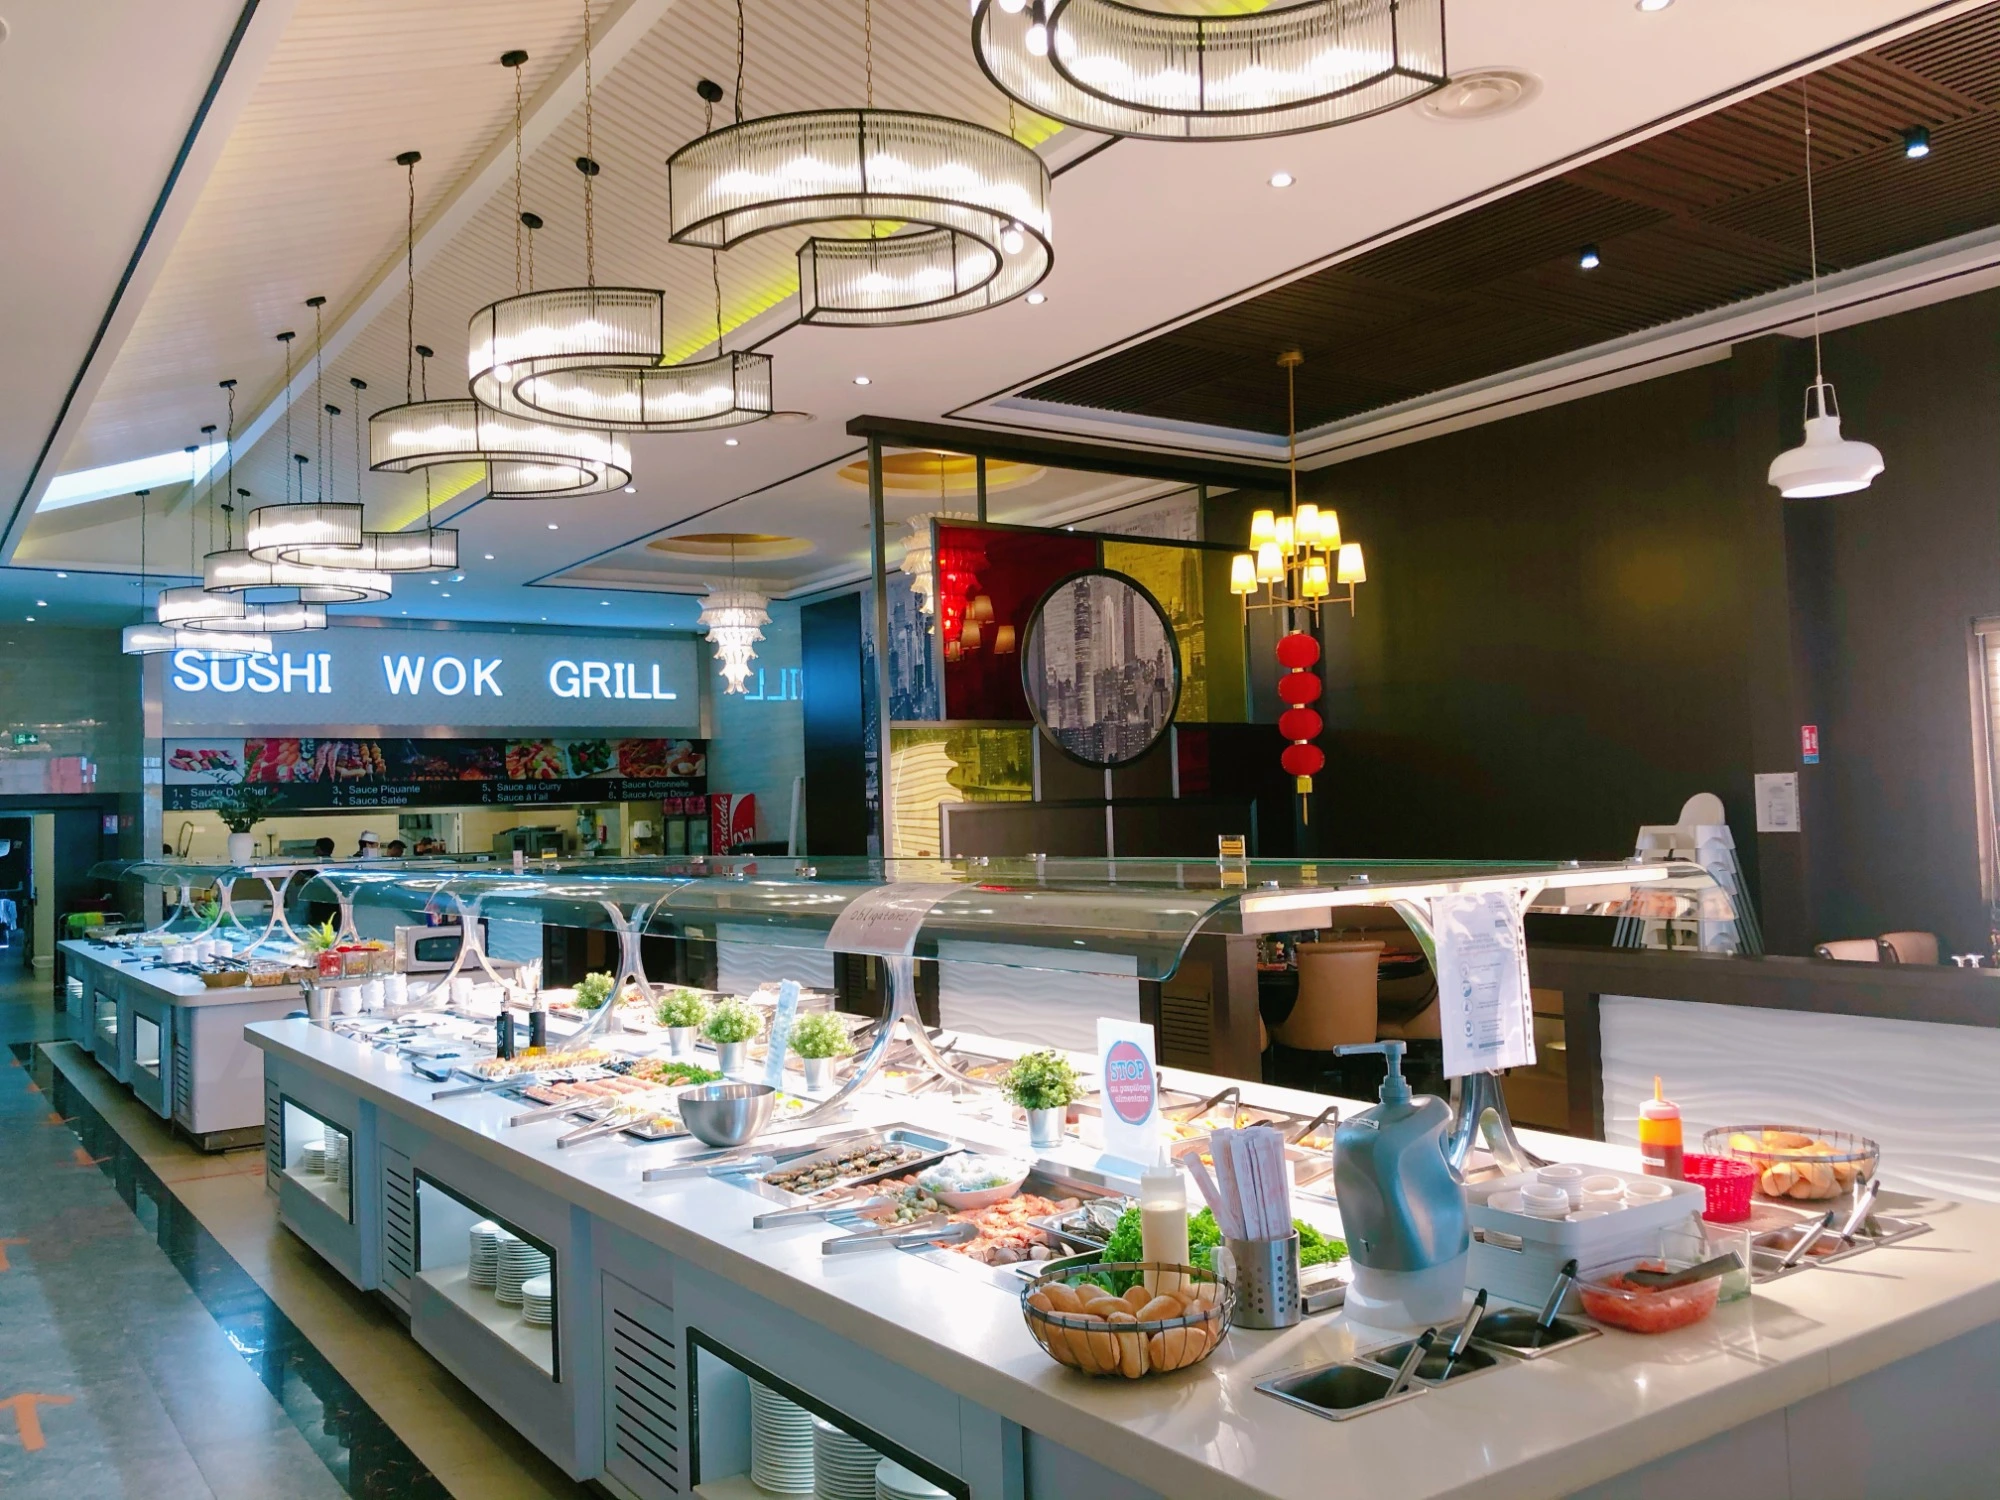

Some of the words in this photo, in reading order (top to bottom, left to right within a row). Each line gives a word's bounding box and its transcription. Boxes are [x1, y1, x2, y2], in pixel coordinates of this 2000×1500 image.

[173, 648, 332, 694] SUSHI
[383, 655, 503, 697] WOK
[549, 660, 677, 700] GRILL
[348, 785, 378, 794] Sauce
[380, 784, 420, 795] Piquante
[496, 783, 524, 792] Sauce
[526, 783, 537, 791] au
[539, 782, 562, 792] Curry
[621, 780, 647, 789] Sauce
[648, 780, 689, 788] Citronnelle
[190, 788, 223, 797] Sauce
[497, 793, 524, 802] Sauce
[622, 790, 647, 799] Sauce
[648, 790, 668, 800] Aigre
[670, 789, 695, 798] Douce
[348, 796, 378, 805] Sauce
[1110, 1059, 1145, 1081] STOP
